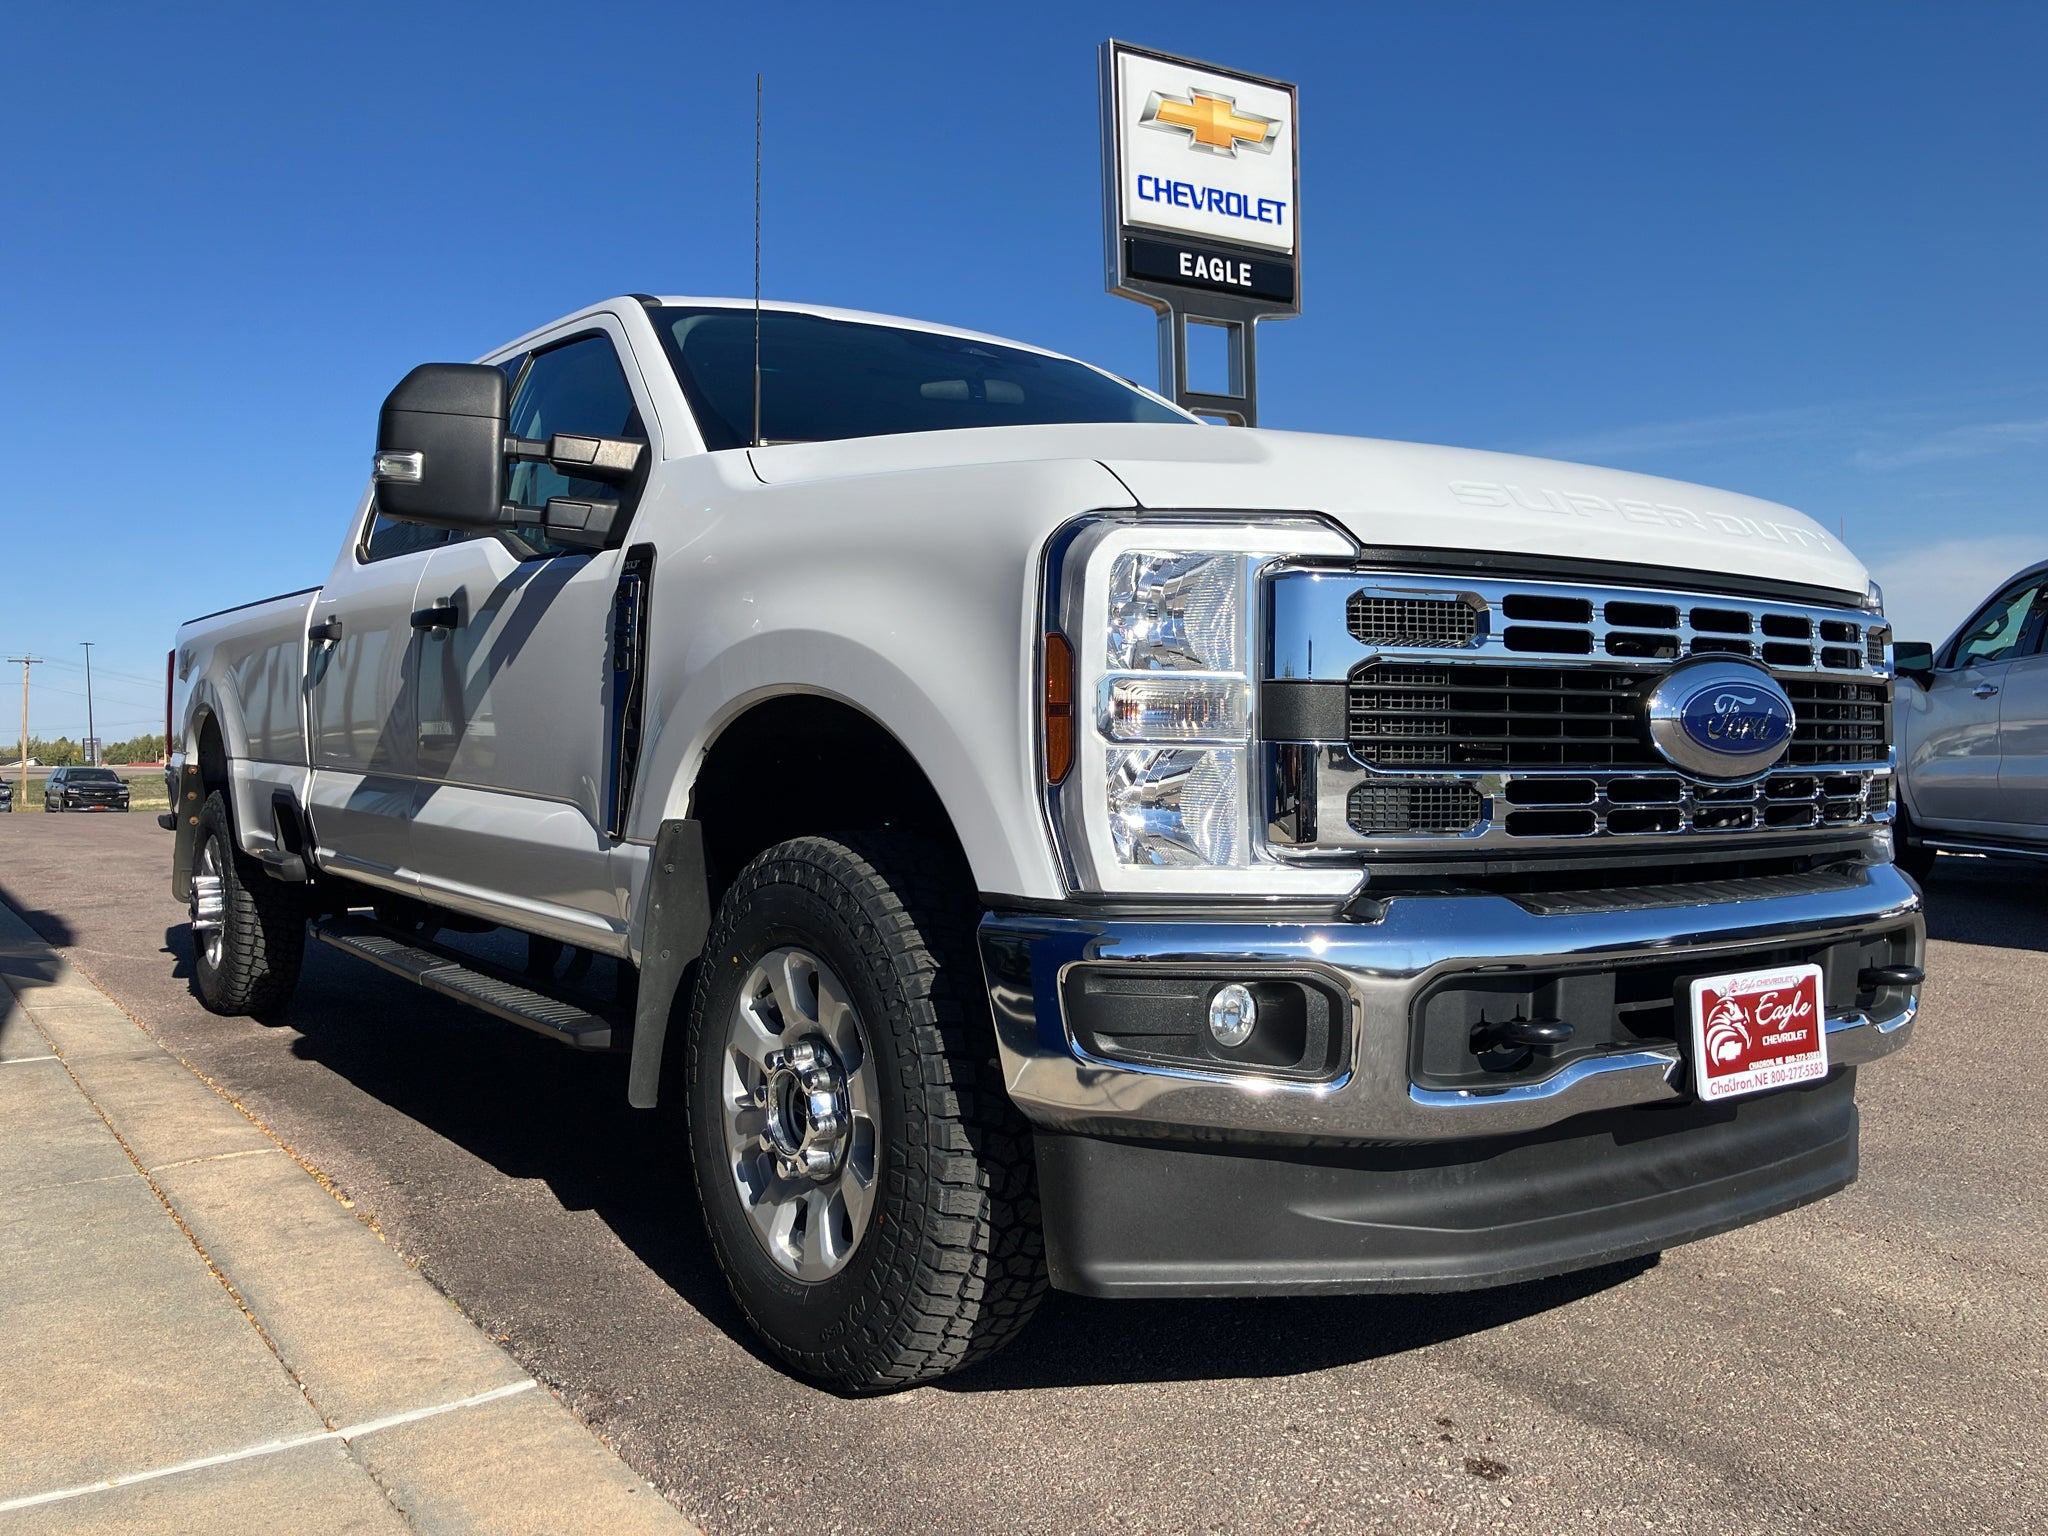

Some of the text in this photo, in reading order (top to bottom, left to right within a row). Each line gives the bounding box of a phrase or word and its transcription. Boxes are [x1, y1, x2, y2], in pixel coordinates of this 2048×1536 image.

[1137, 174, 1286, 225] CHEVROLET
[1179, 252, 1252, 286] EAGLE
[1447, 480, 1832, 552] SUPER DUTY
[1708, 693, 1773, 740] Ford
[1756, 975, 1793, 987] CHEVROLET
[1755, 990, 1812, 1031] Eagle
[1762, 1029, 1808, 1046] CHEVROLET
